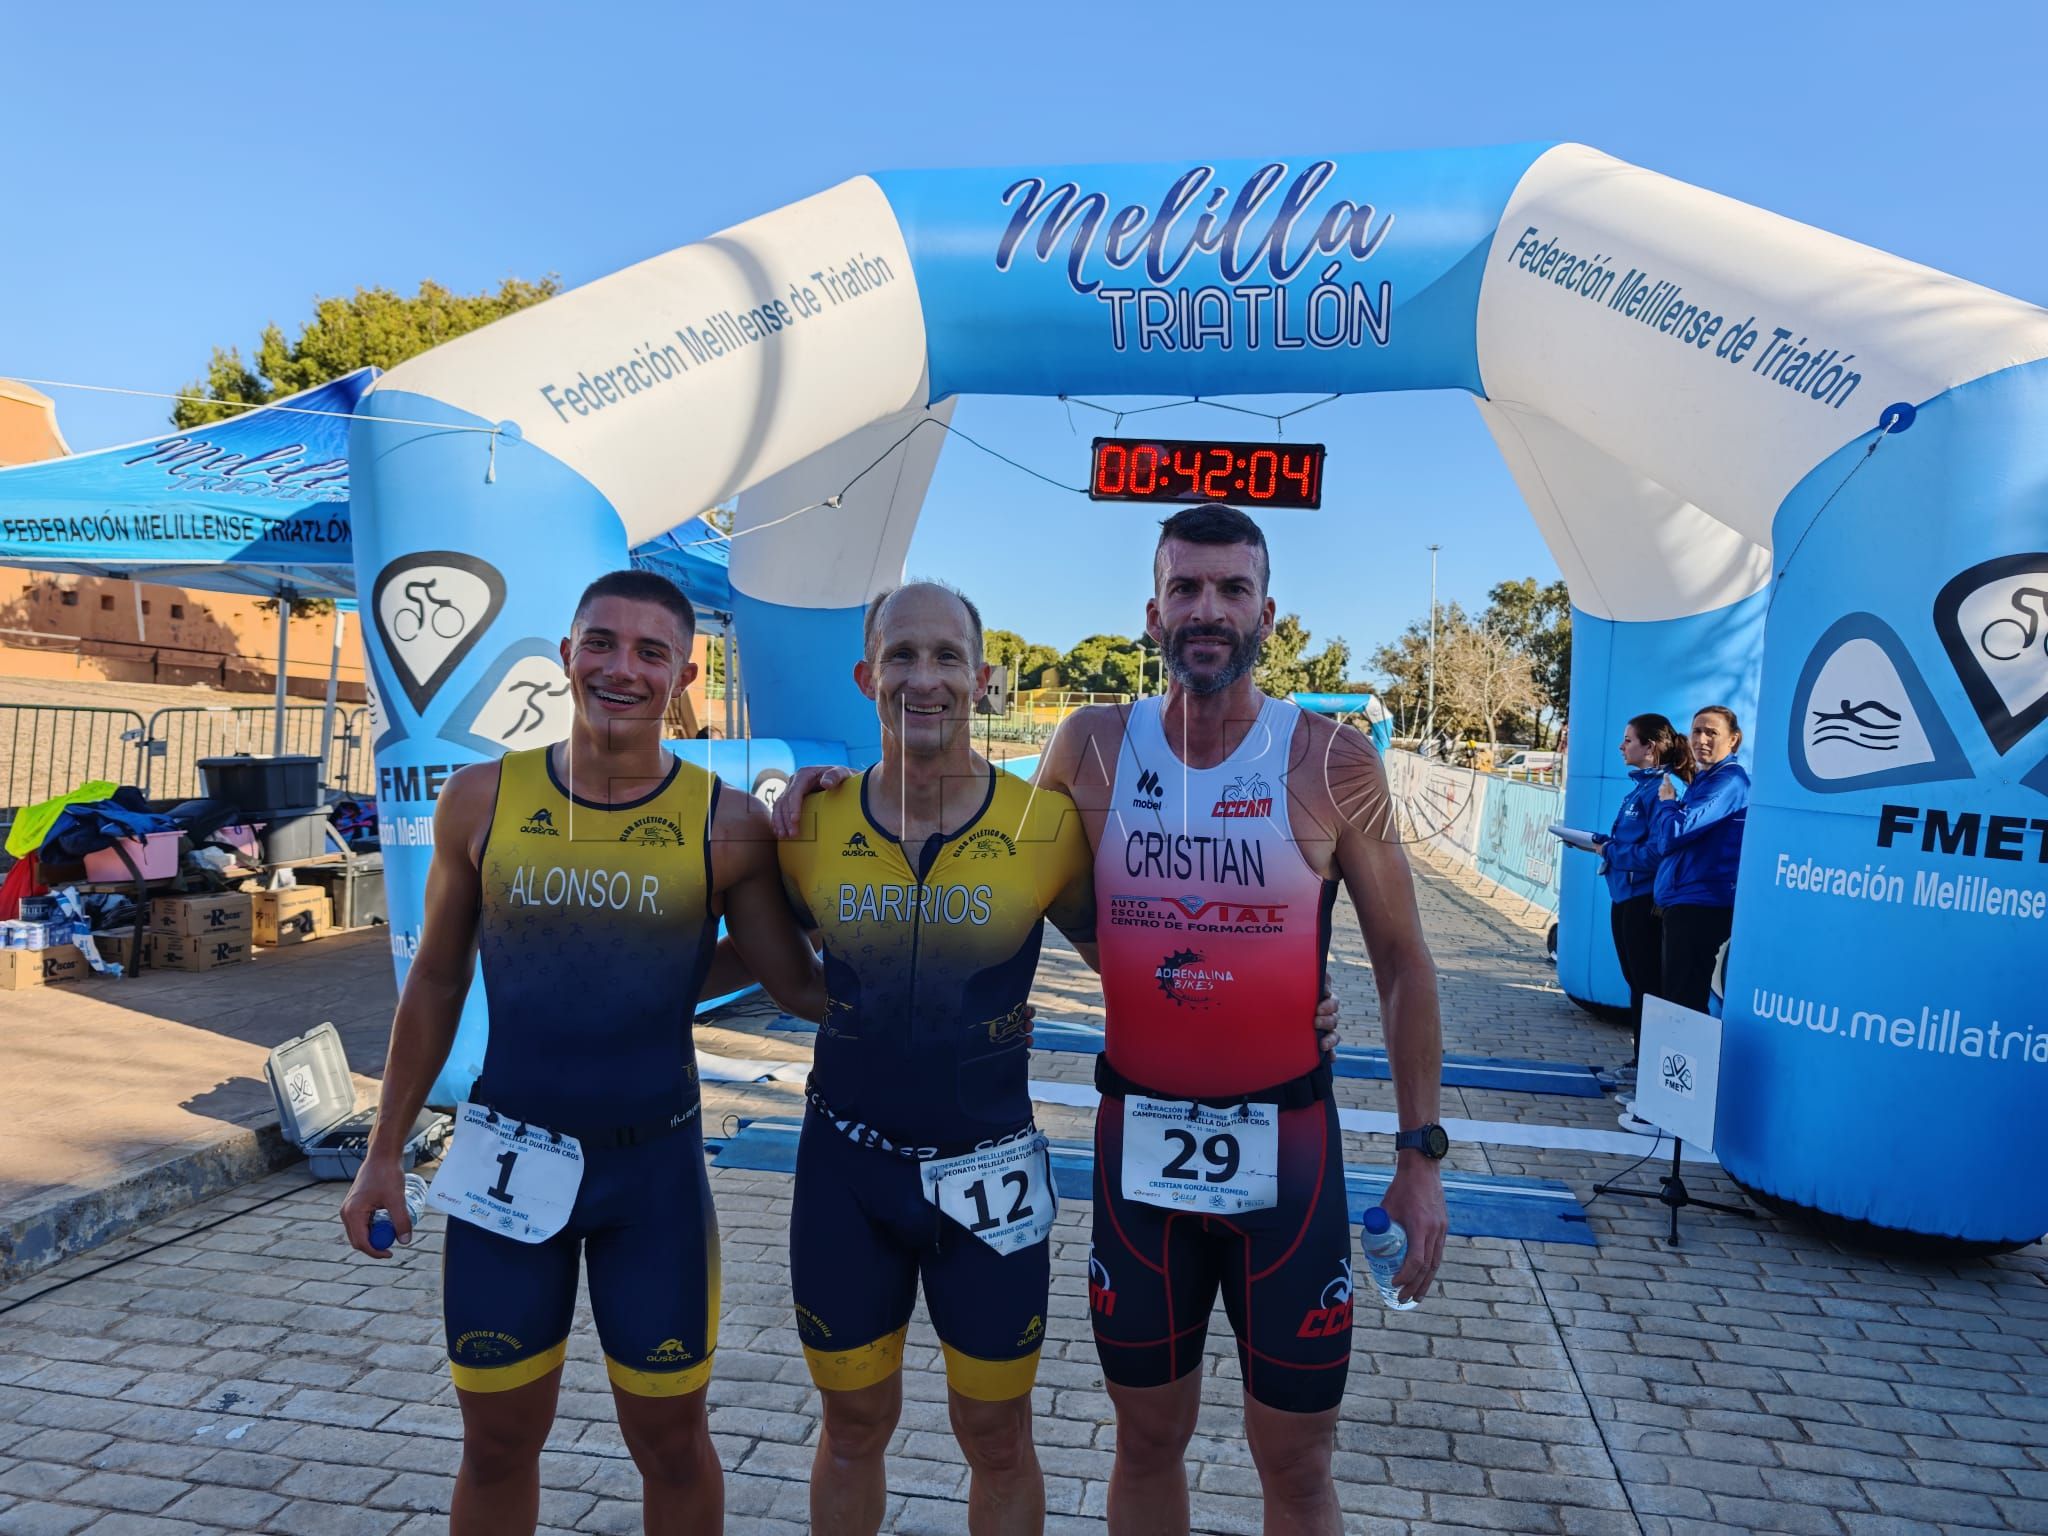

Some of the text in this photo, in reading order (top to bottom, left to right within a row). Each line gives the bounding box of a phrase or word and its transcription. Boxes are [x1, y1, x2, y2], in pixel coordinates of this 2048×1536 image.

[995, 160, 1396, 294] Melilla
[1098, 260, 1392, 352] TRIATLÓN
[1508, 226, 1862, 408] Federación Melillense de Triatlón
[540, 252, 895, 424] Federación Melillense de Triatlón
[1098, 445, 1311, 498] 00:42:04
[3, 508, 353, 543] FEDERACIÓN MELILLENSE TRIATLÓN
[1132, 798, 1162, 811] mobel
[1125, 830, 1265, 887] CRISTIAN
[509, 865, 664, 915] ALONSO R.
[839, 883, 992, 926] BARRIOS
[1111, 899, 1148, 909] AUTO
[1775, 853, 2046, 919] Federación Melillense
[1111, 909, 1177, 920] ESCUELA
[1111, 917, 1283, 933] CENTRO DE FORMACIÓN
[1154, 967, 1235, 982] ADRENALINA
[1173, 980, 1215, 991] BIKES
[1665, 1079, 1684, 1093] FMET
[1250, 1118, 1270, 1126] CROS
[529, 1140, 560, 1155] DUATLÓN
[562, 1150, 579, 1160] CROS
[1162, 1128, 1240, 1183] 29
[487, 1150, 518, 1204] 1
[1149, 1181, 1182, 1189] CRISTIAN
[1220, 1187, 1248, 1196] ROMERO
[964, 1170, 1034, 1232] 12
